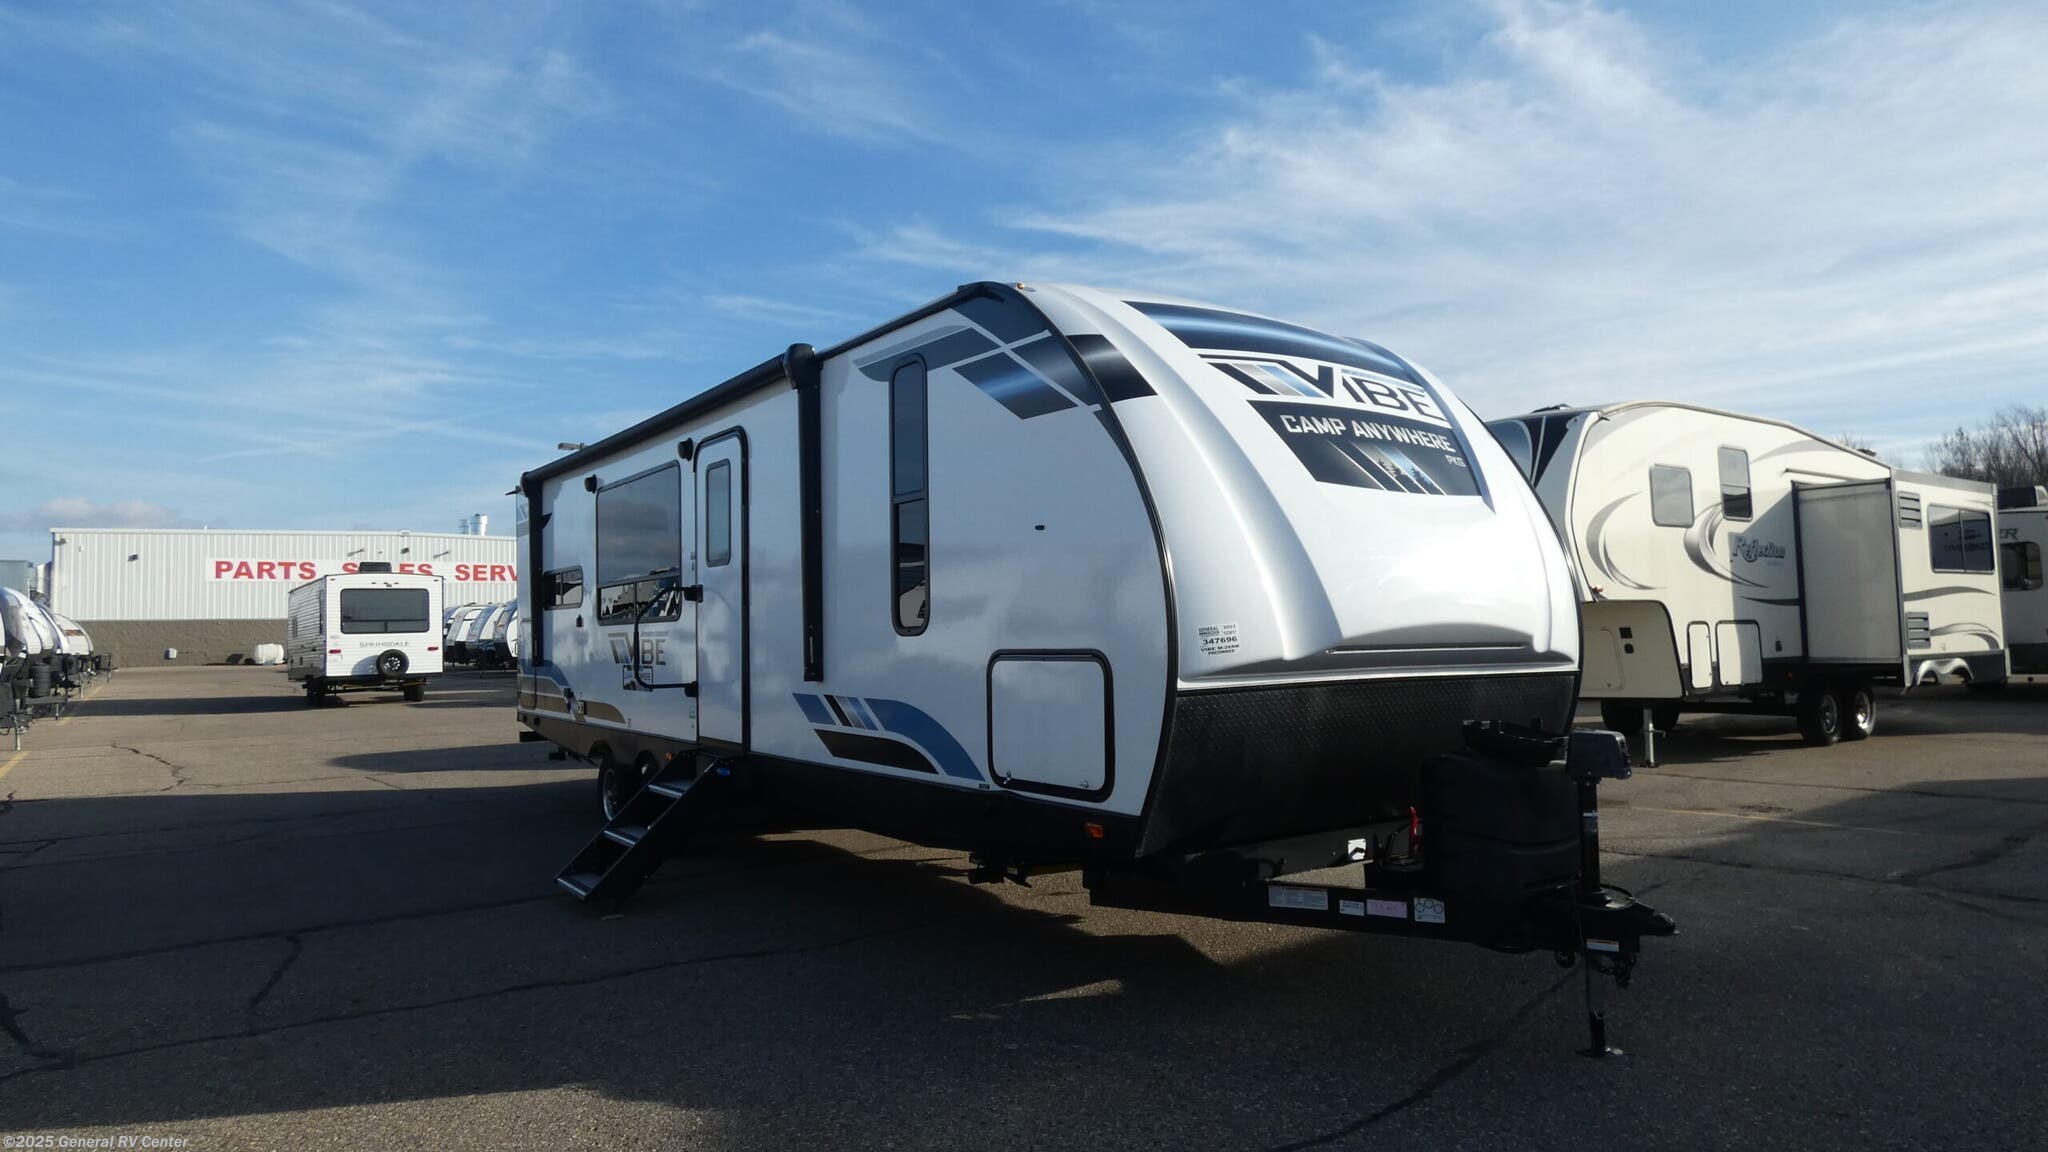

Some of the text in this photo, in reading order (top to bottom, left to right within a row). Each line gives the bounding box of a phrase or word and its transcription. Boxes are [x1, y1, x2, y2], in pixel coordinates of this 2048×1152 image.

[1200, 355, 1448, 422] VIBE
[1280, 414, 1456, 453] CAMP ANYWHERE
[1733, 535, 1786, 563] Reflection
[215, 560, 316, 580] PARTS
[608, 632, 667, 666] VBE
[1202, 636, 1238, 645] 347696
